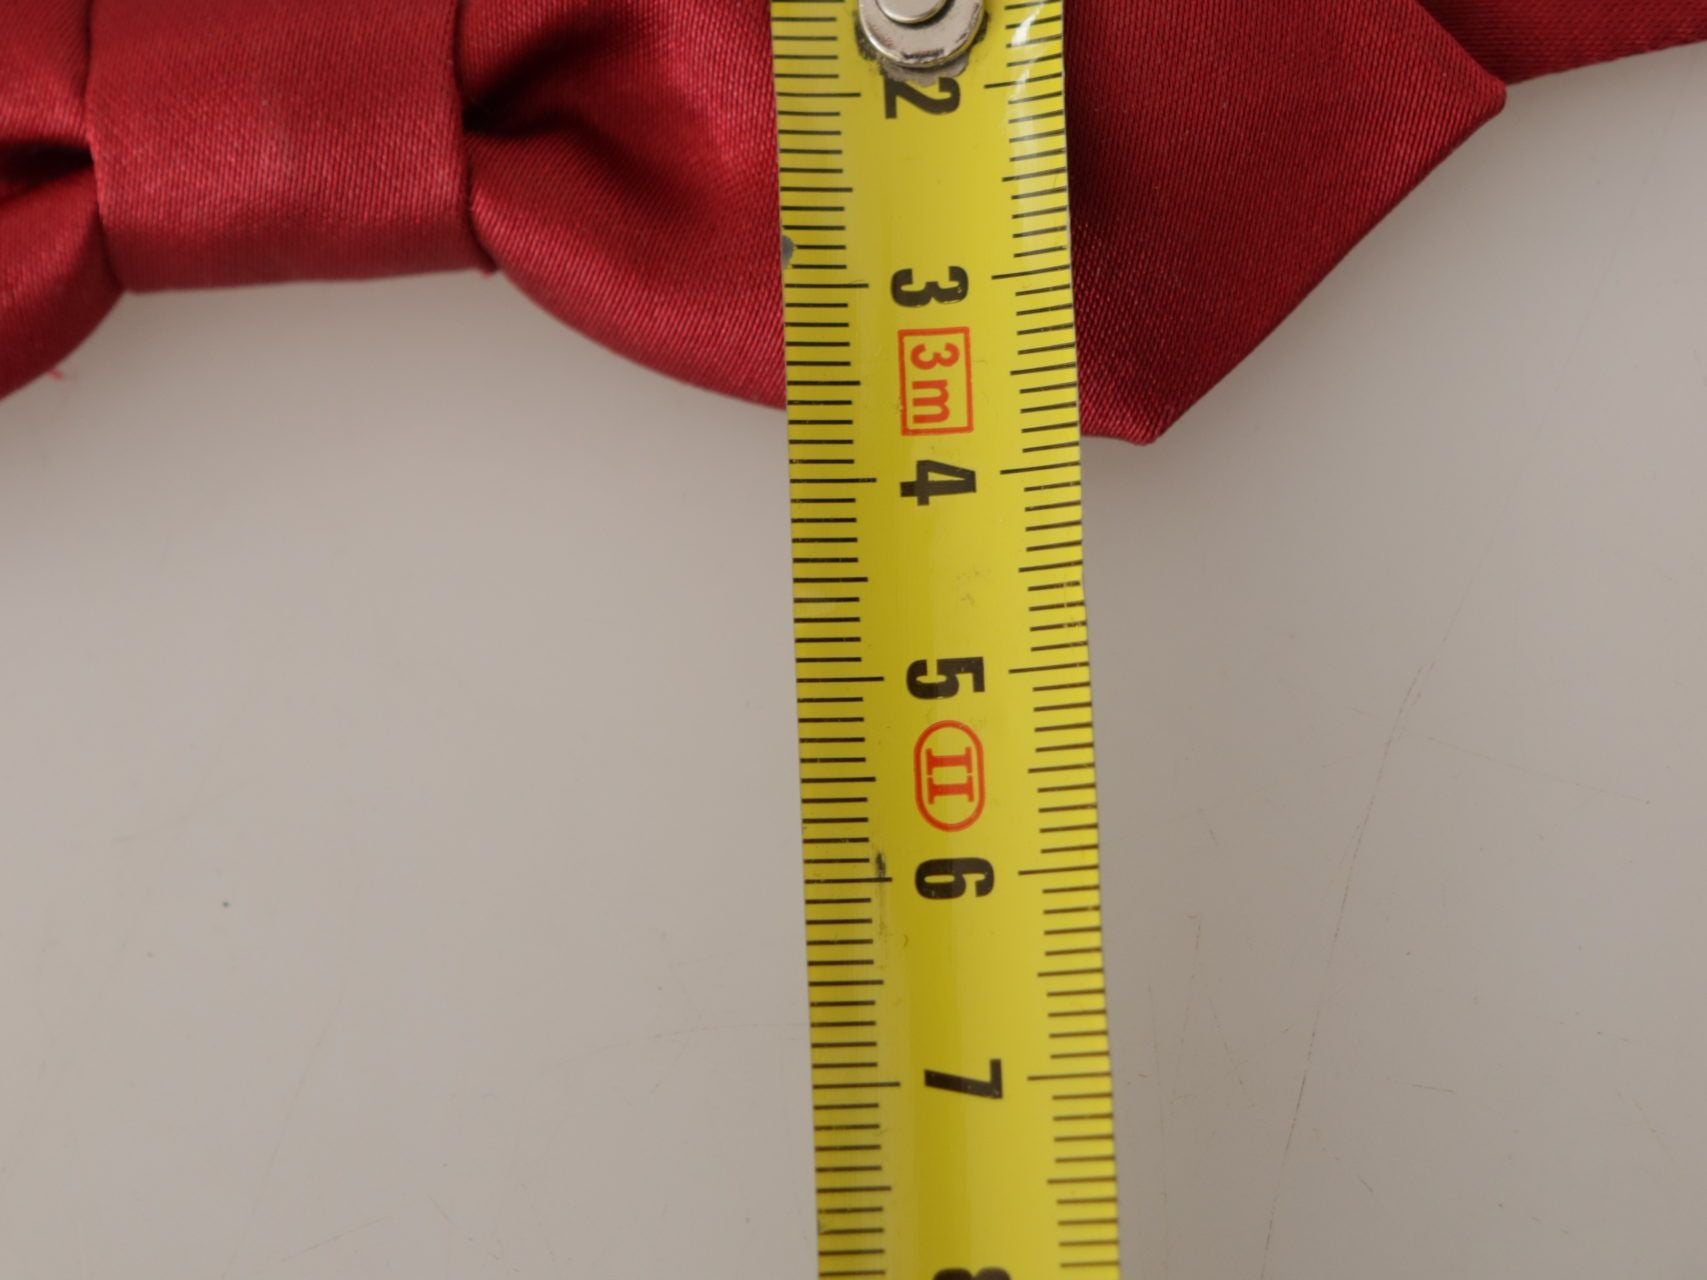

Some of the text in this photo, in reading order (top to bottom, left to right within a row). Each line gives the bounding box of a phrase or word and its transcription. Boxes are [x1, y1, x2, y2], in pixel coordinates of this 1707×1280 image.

[883, 76, 961, 119] 2
[890, 266, 969, 307] 3
[910, 343, 962, 425] 3m
[900, 459, 976, 506] 4
[906, 656, 985, 700] 5
[914, 857, 995, 900] 6
[924, 1058, 1003, 1100] 7
